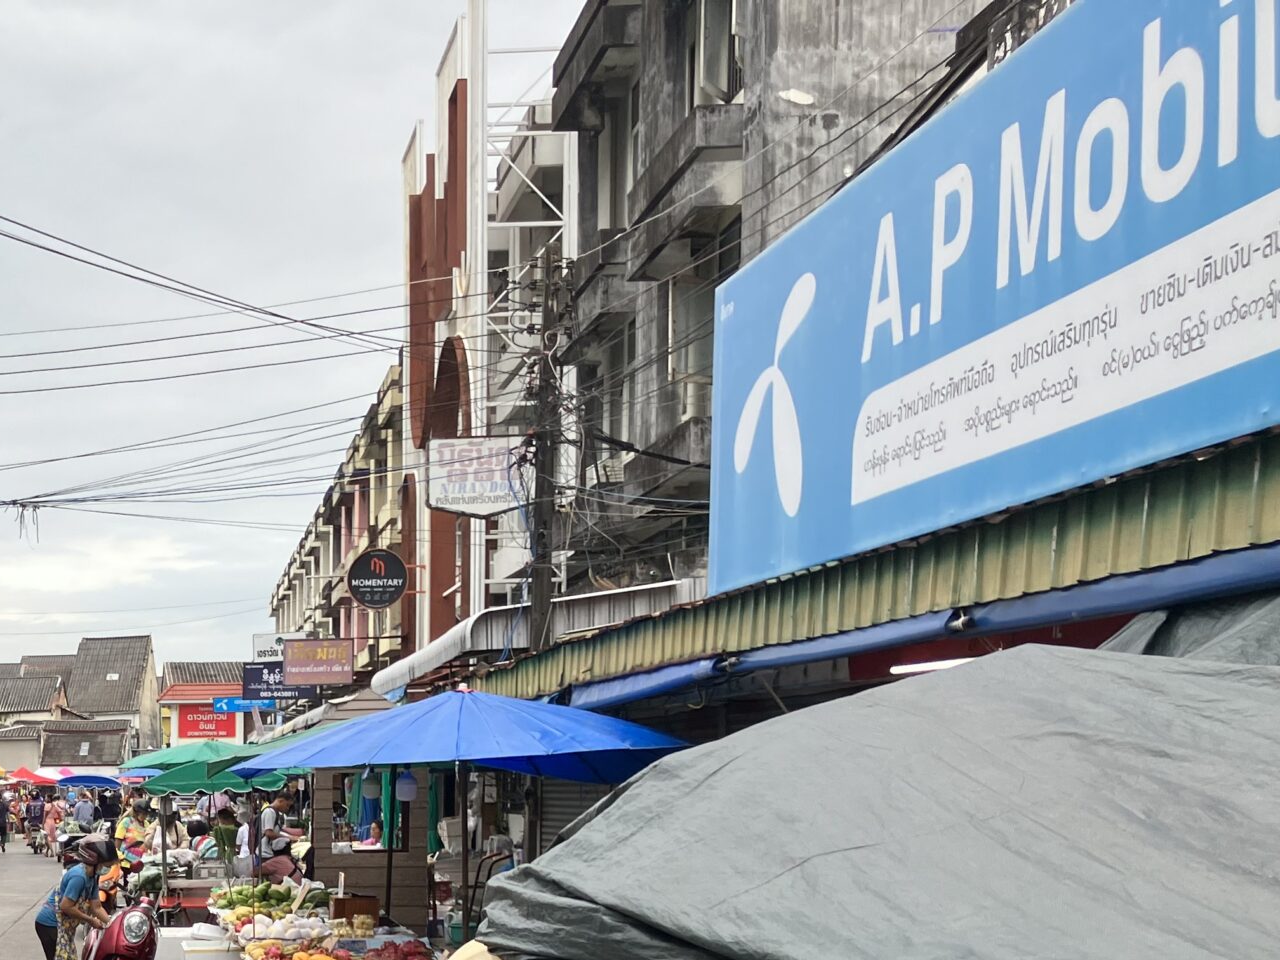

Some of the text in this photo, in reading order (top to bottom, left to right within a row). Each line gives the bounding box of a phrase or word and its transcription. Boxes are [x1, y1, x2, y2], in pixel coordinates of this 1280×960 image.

[862, 163, 973, 363] A.P
[1011, 304, 1117, 379] อุปกรณ์เสริมทุกรุ่น
